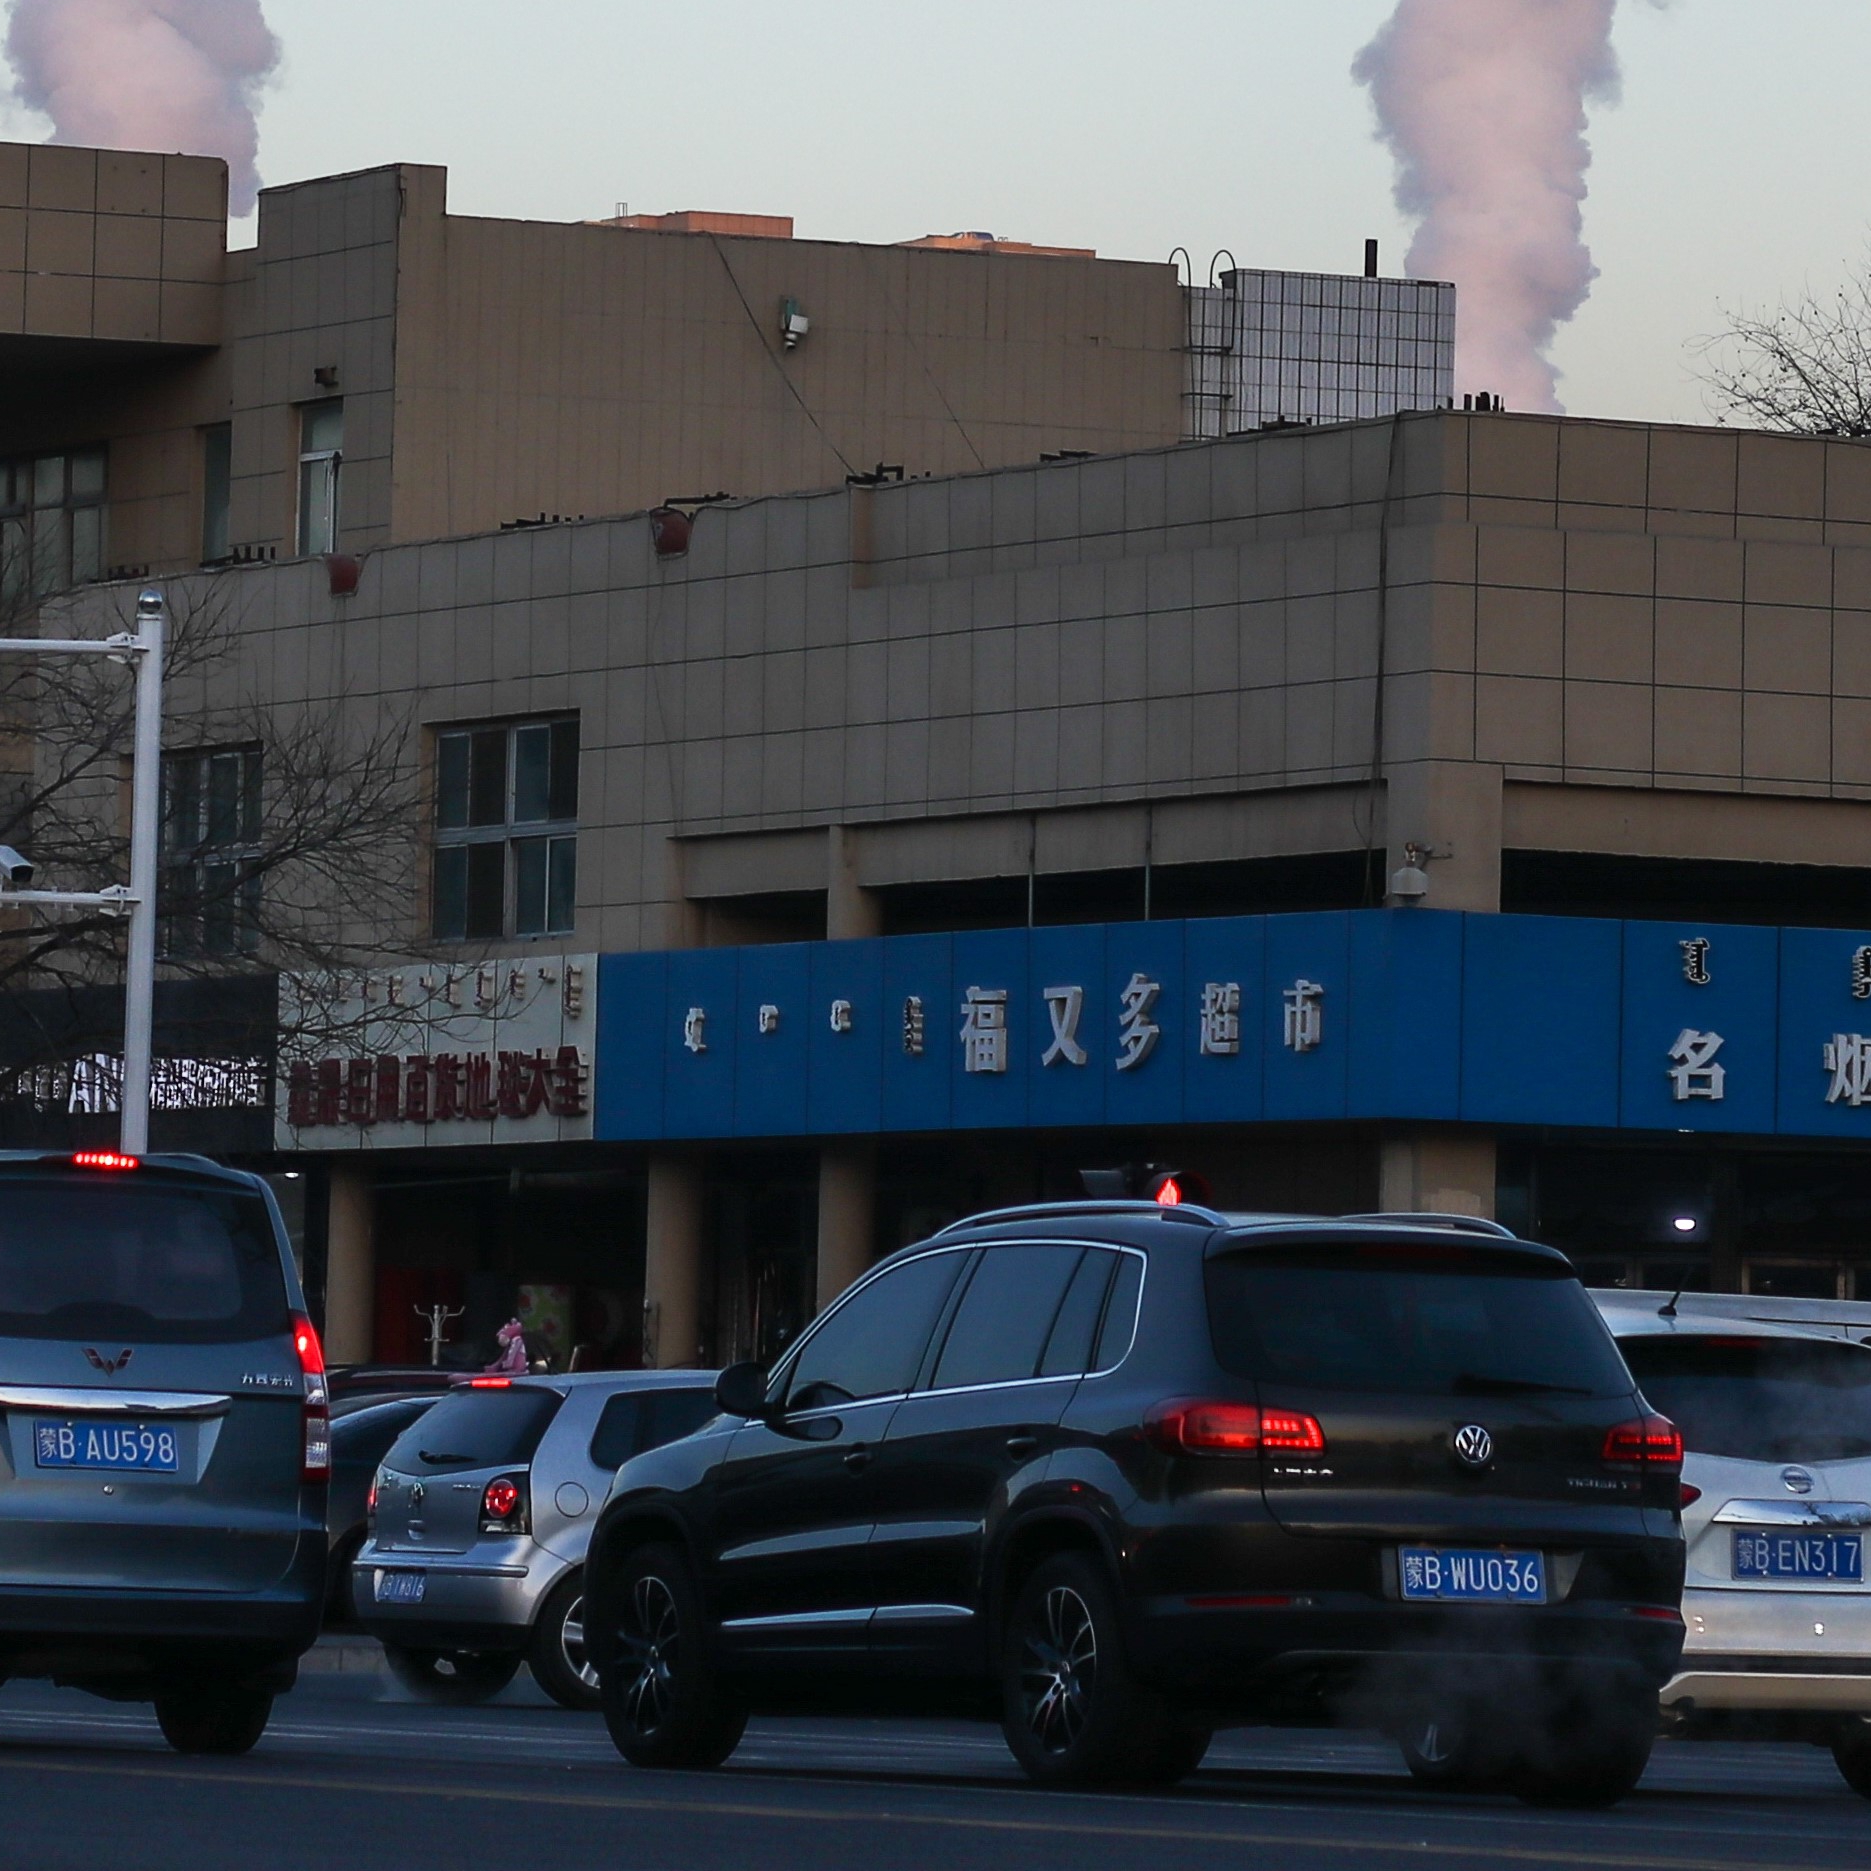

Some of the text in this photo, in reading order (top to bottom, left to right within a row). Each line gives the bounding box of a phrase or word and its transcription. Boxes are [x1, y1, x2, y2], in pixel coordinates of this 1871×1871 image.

[960, 972, 1323, 1073] 福又多超市
[1737, 1538, 1860, 1572] 蒙B·EN317
